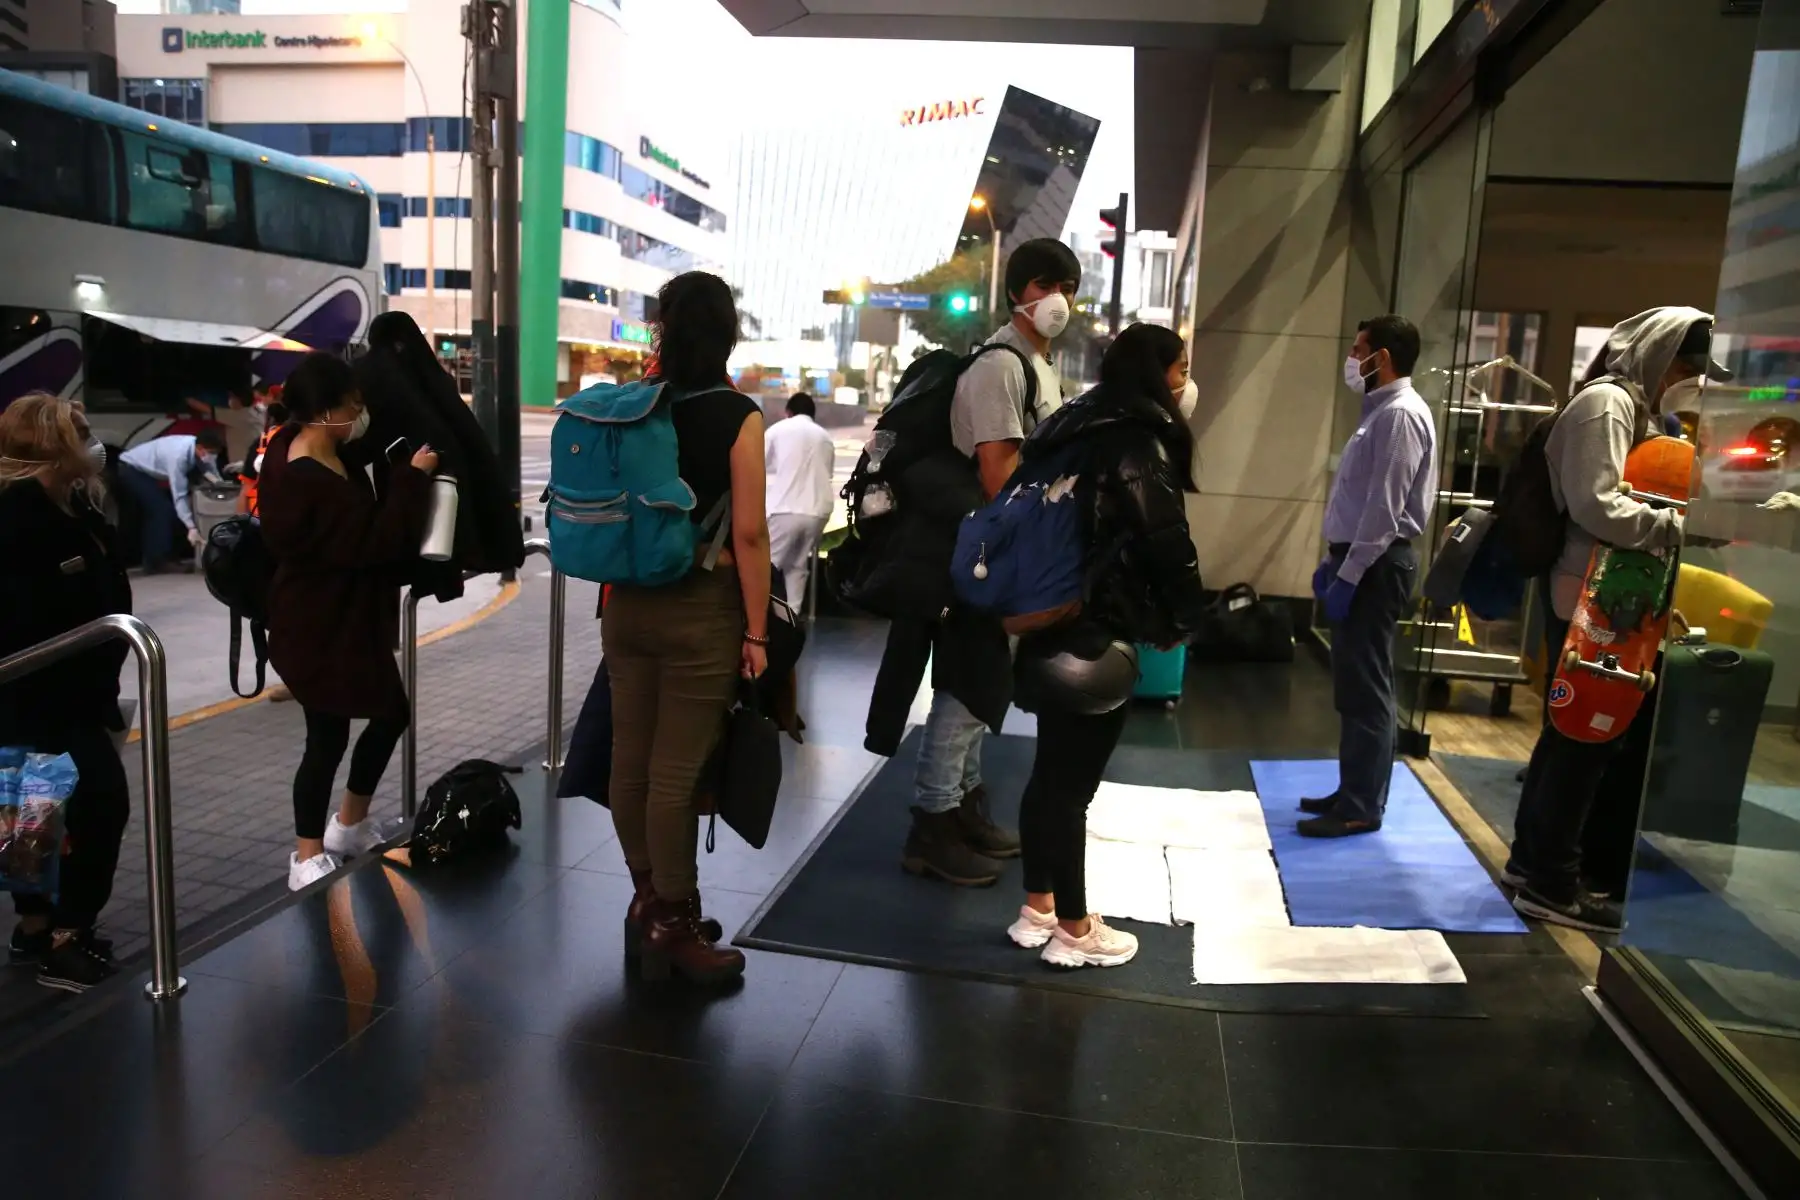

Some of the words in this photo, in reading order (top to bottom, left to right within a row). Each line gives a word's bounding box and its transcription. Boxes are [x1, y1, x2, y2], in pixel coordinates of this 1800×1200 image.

[185, 30, 267, 48] Interbank
[274, 35, 306, 48] Centro
[900, 96, 984, 127] RIMAC
